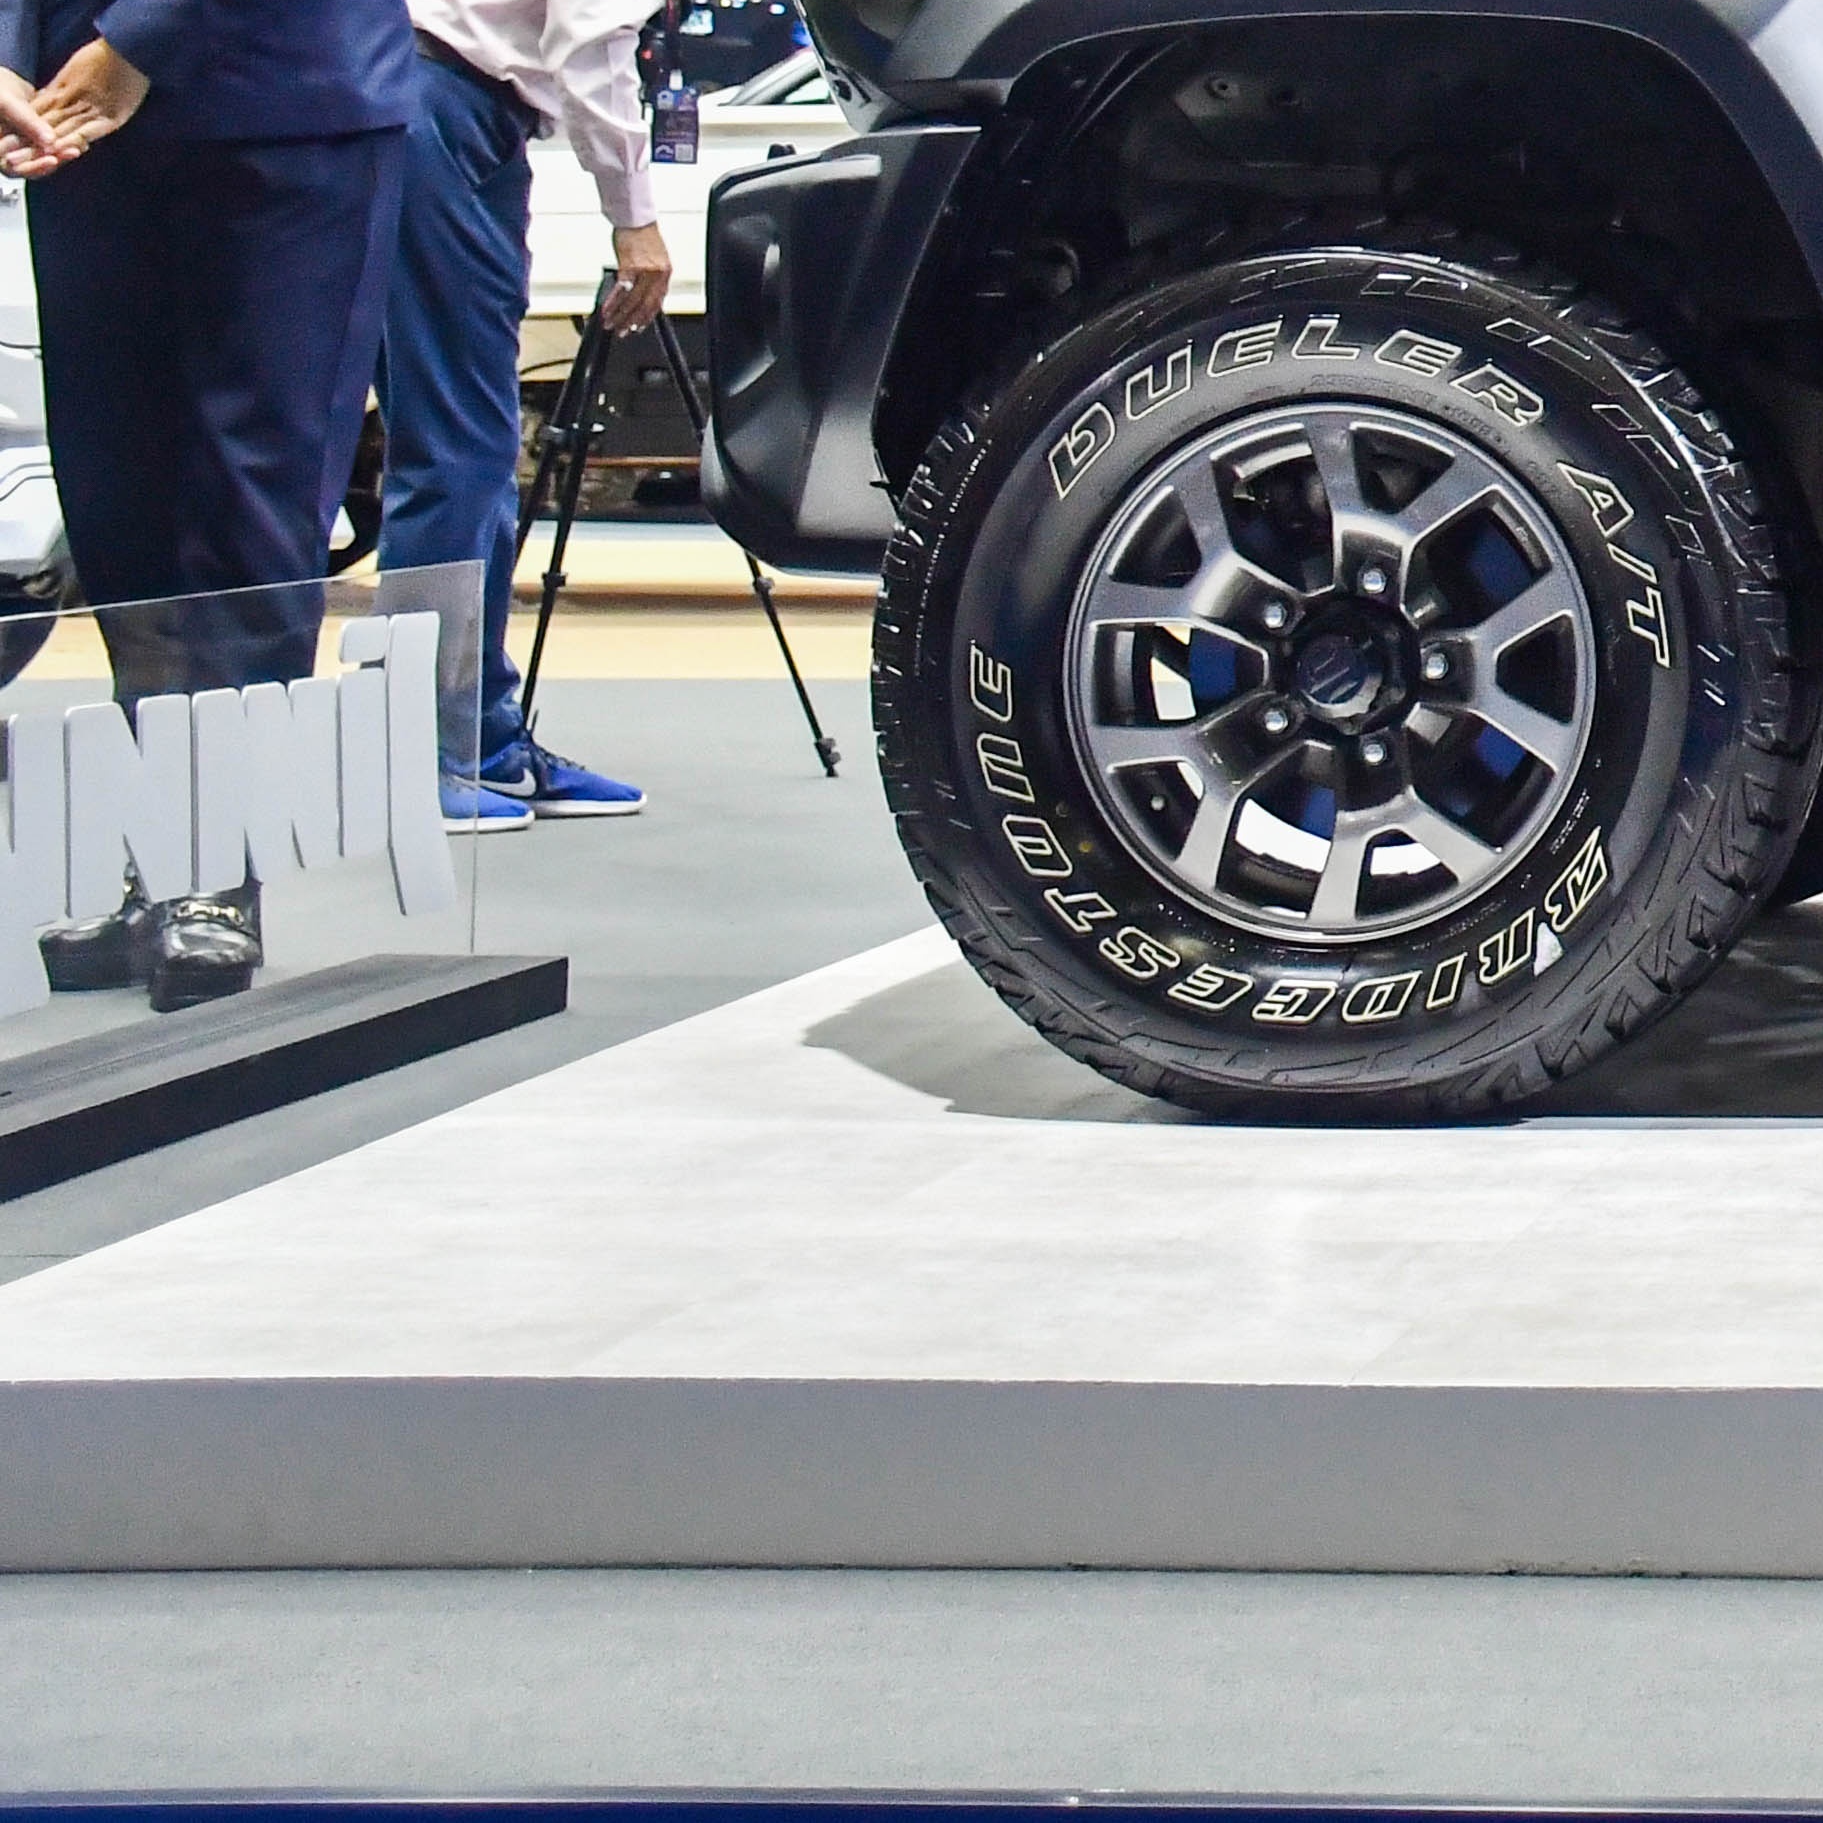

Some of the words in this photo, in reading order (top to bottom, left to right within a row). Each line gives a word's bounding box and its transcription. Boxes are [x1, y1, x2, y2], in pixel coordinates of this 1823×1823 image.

[1048, 314, 1546, 499] DUELER
[1556, 461, 1672, 669] A/T
[967, 645, 1609, 1025] BRIDGESTONE
